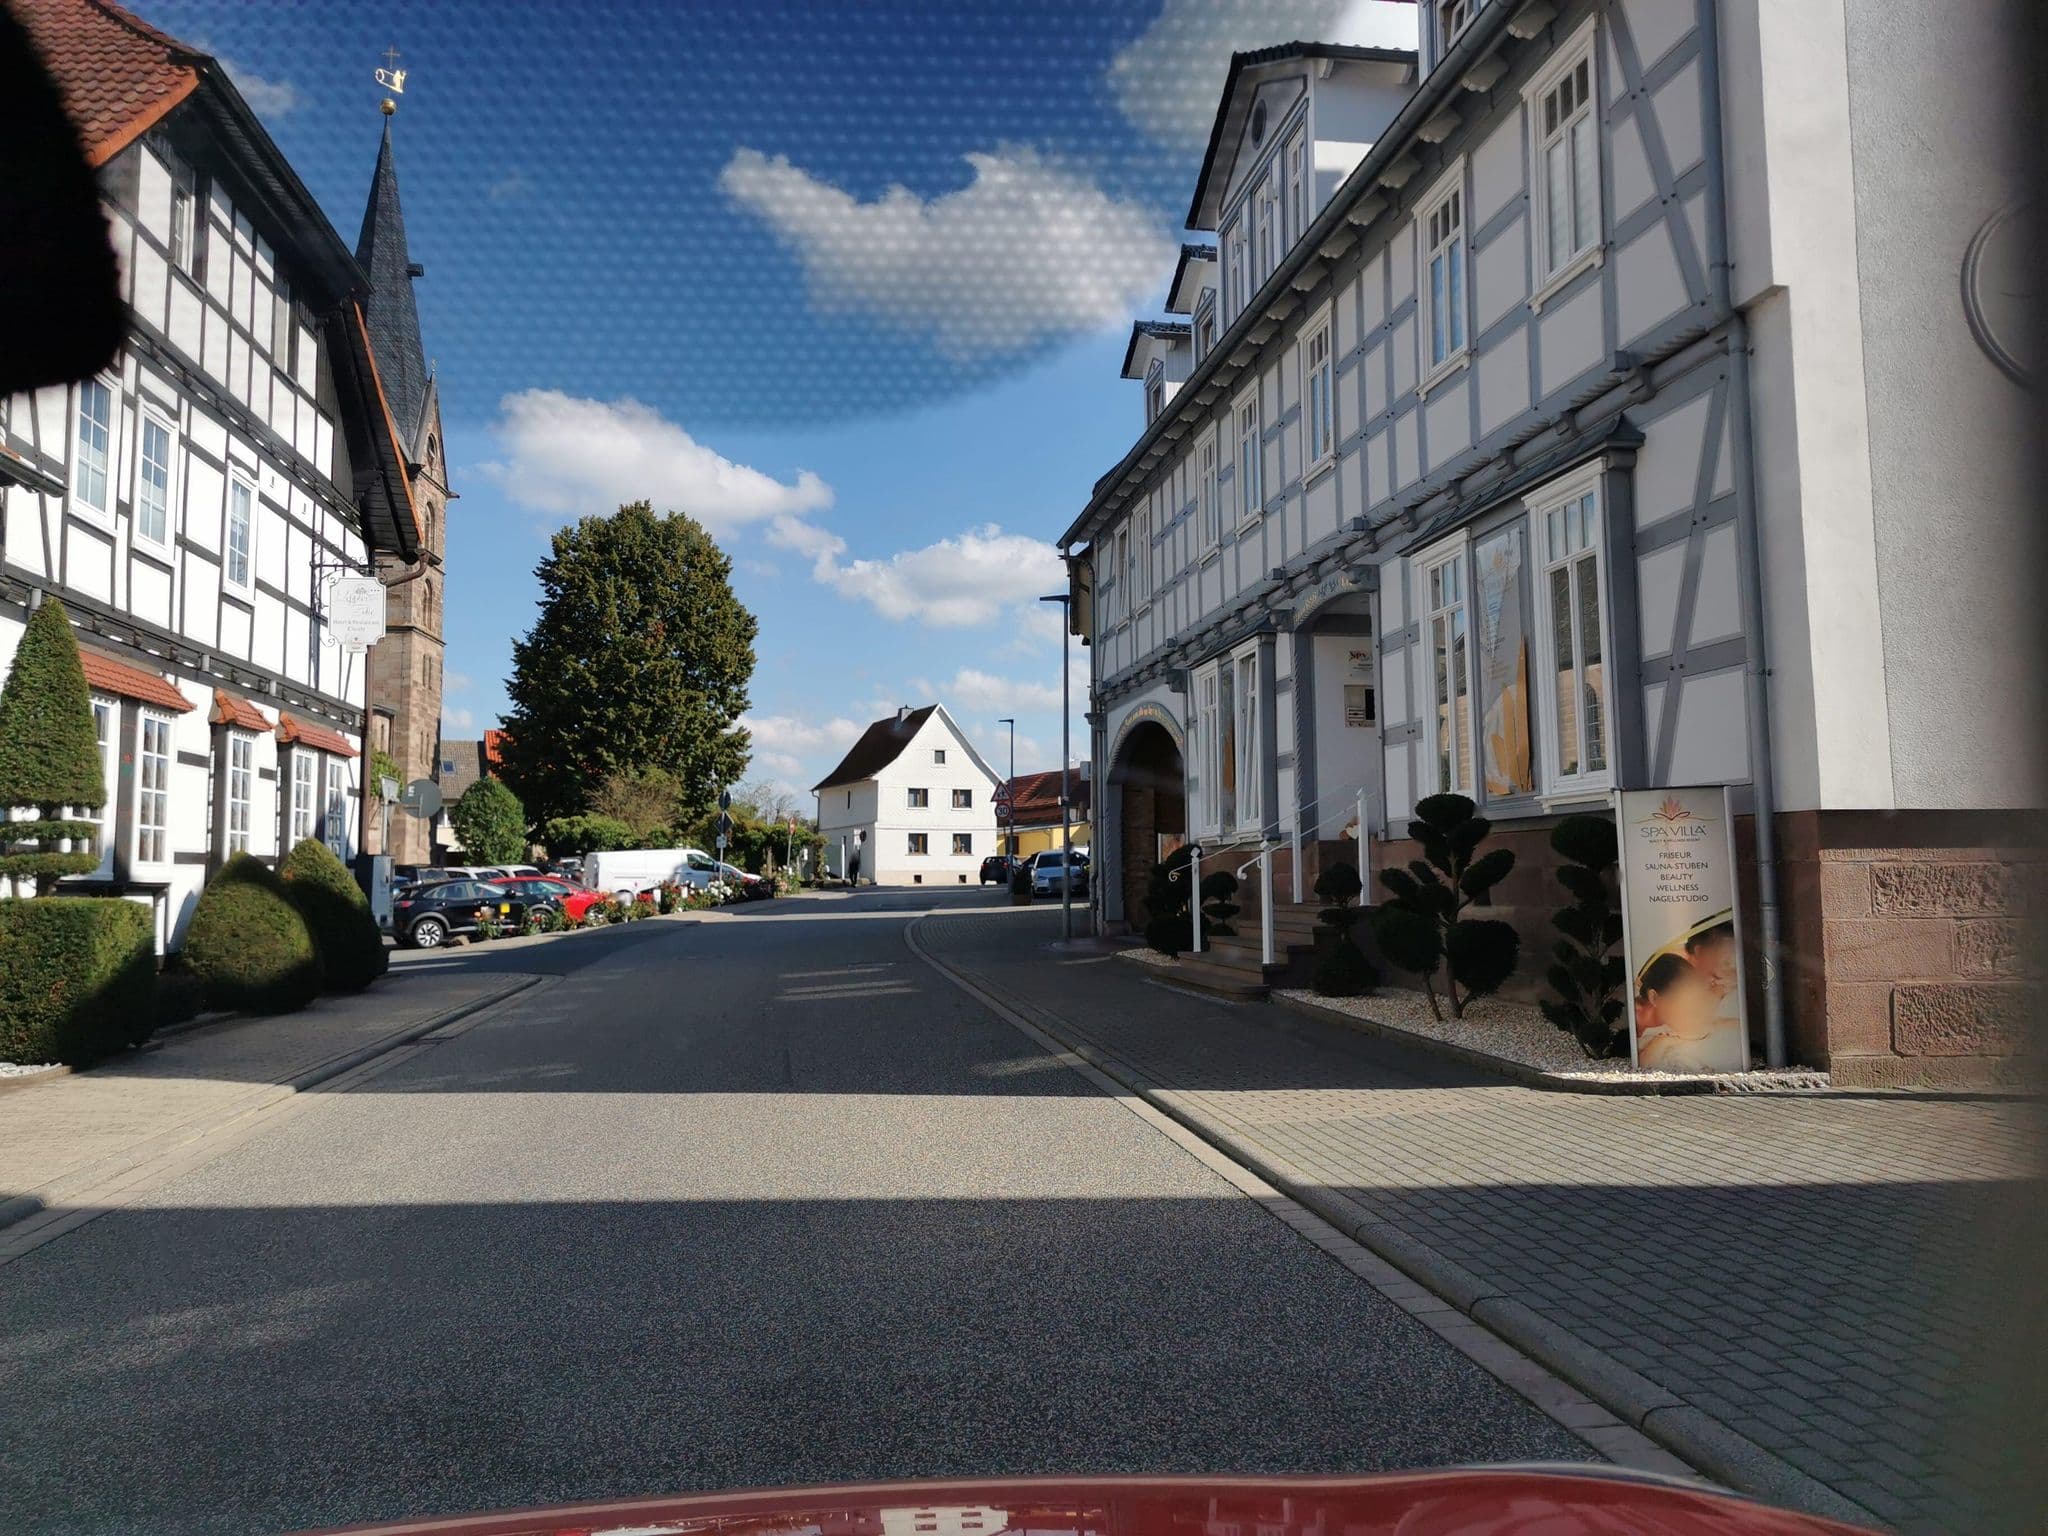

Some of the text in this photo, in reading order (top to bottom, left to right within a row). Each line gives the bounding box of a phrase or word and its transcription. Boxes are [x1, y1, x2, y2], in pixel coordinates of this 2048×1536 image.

[998, 807, 1008, 816] 30
[1641, 825, 1706, 837] SPA VILLA
